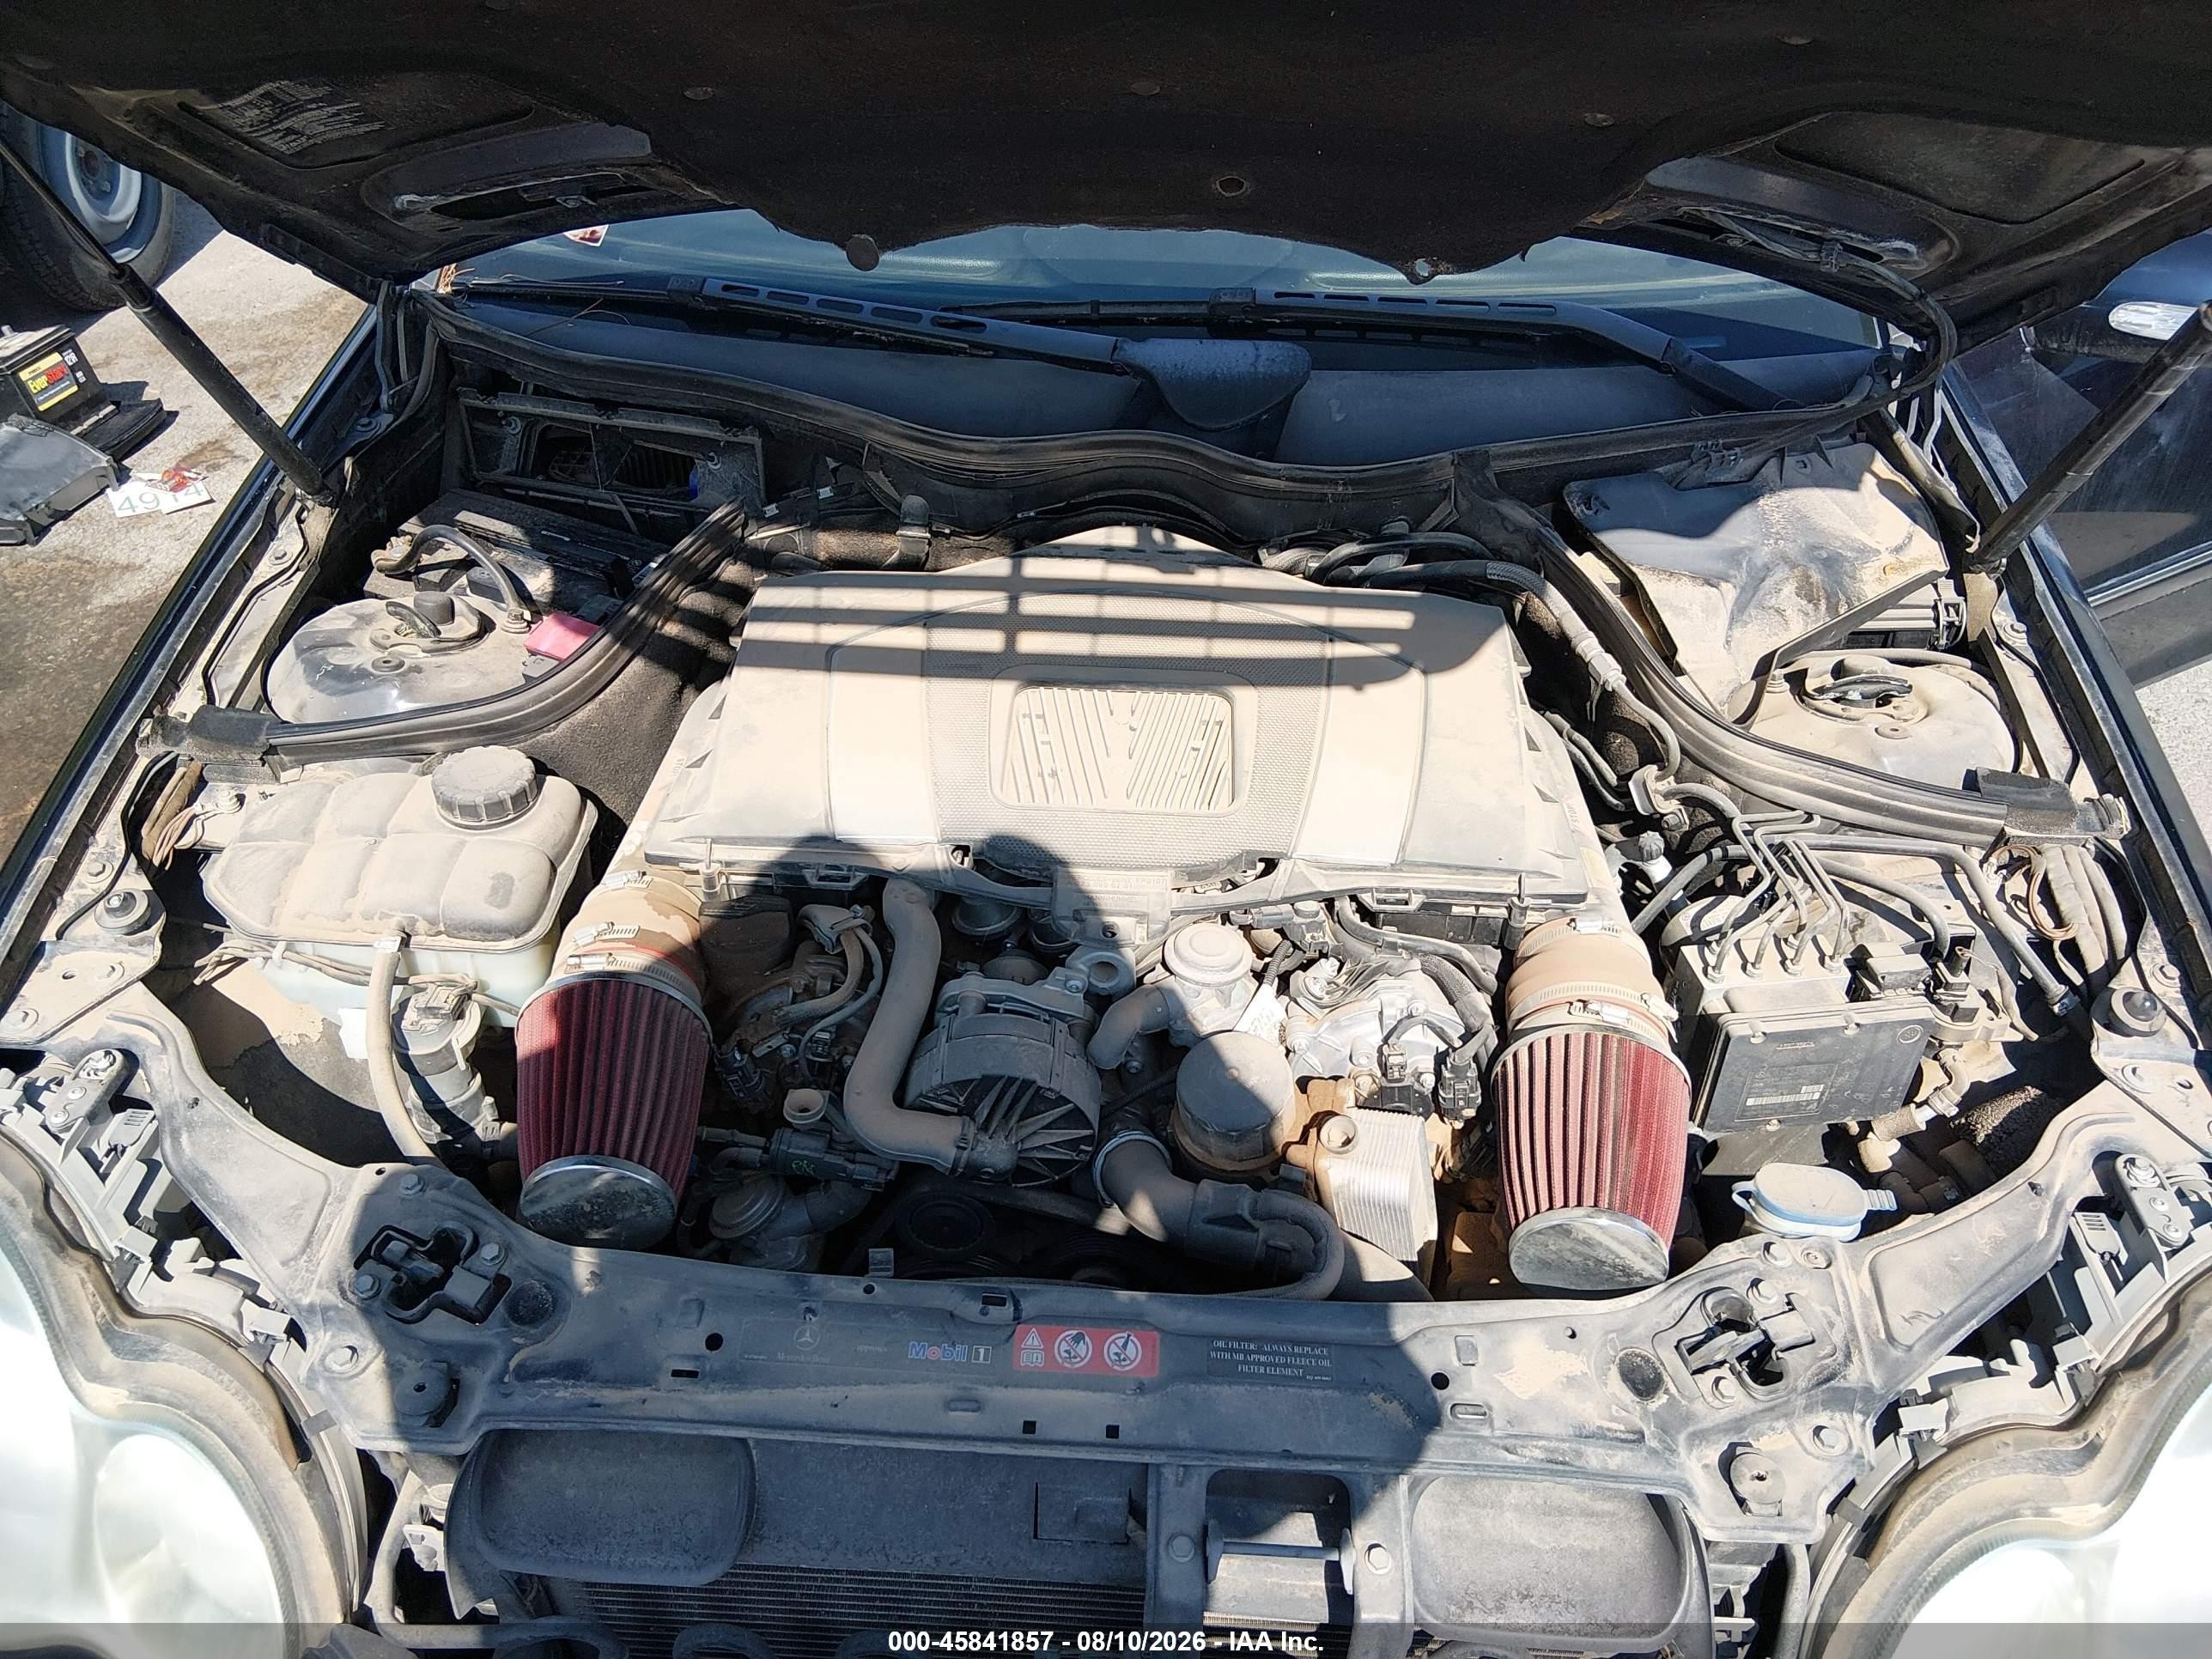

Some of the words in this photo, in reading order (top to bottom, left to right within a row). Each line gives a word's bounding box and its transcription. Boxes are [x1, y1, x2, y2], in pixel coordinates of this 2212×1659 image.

[908, 1341, 968, 1362] Mobil
[974, 1346, 989, 1363] 1
[1212, 1340, 1227, 1349] OIL
[1228, 1340, 1258, 1351] FILTER:
[1261, 1344, 1292, 1353] ALWAYS
[1293, 1345, 1329, 1356] REPLACE
[1210, 1350, 1231, 1360] WITH
[1232, 1352, 1244, 1361] MB
[1245, 1352, 1286, 1364] APPROVED
[1287, 1356, 1317, 1366] FLEECE
[1318, 1358, 1332, 1368] OIL
[1237, 1364, 1265, 1374] FILTER
[1266, 1365, 1304, 1376] ELEMENT
